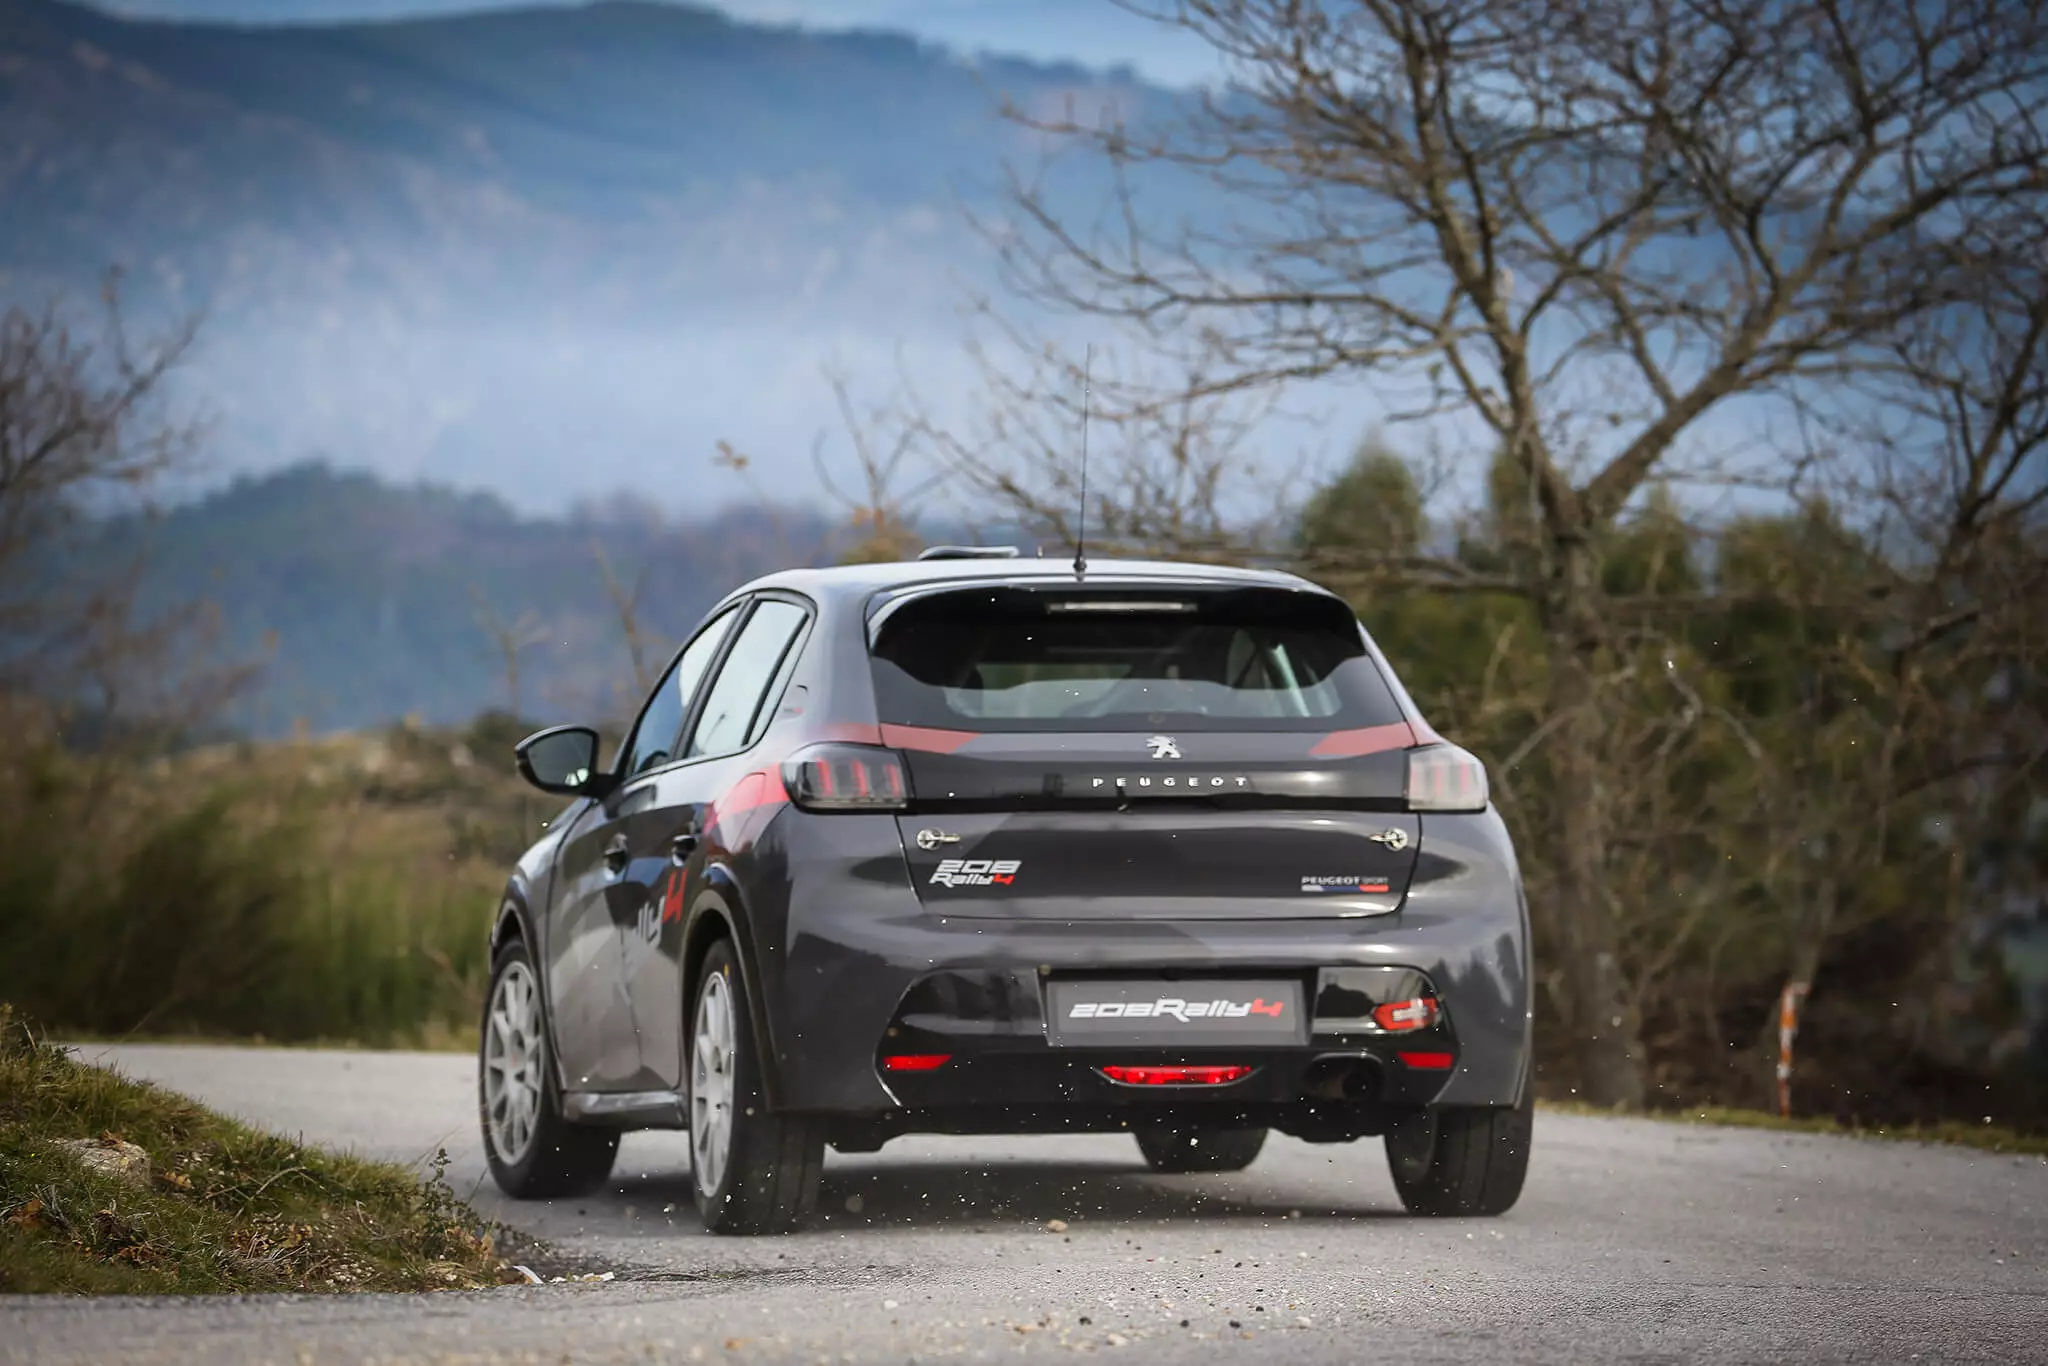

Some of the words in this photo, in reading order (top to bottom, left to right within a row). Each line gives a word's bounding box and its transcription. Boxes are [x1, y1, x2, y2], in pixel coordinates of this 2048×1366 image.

[1092, 777, 1247, 787] PEUGEOT
[936, 859, 1022, 874] 208
[929, 872, 1015, 888] Rally4
[1301, 876, 1360, 885] PEUGEOT
